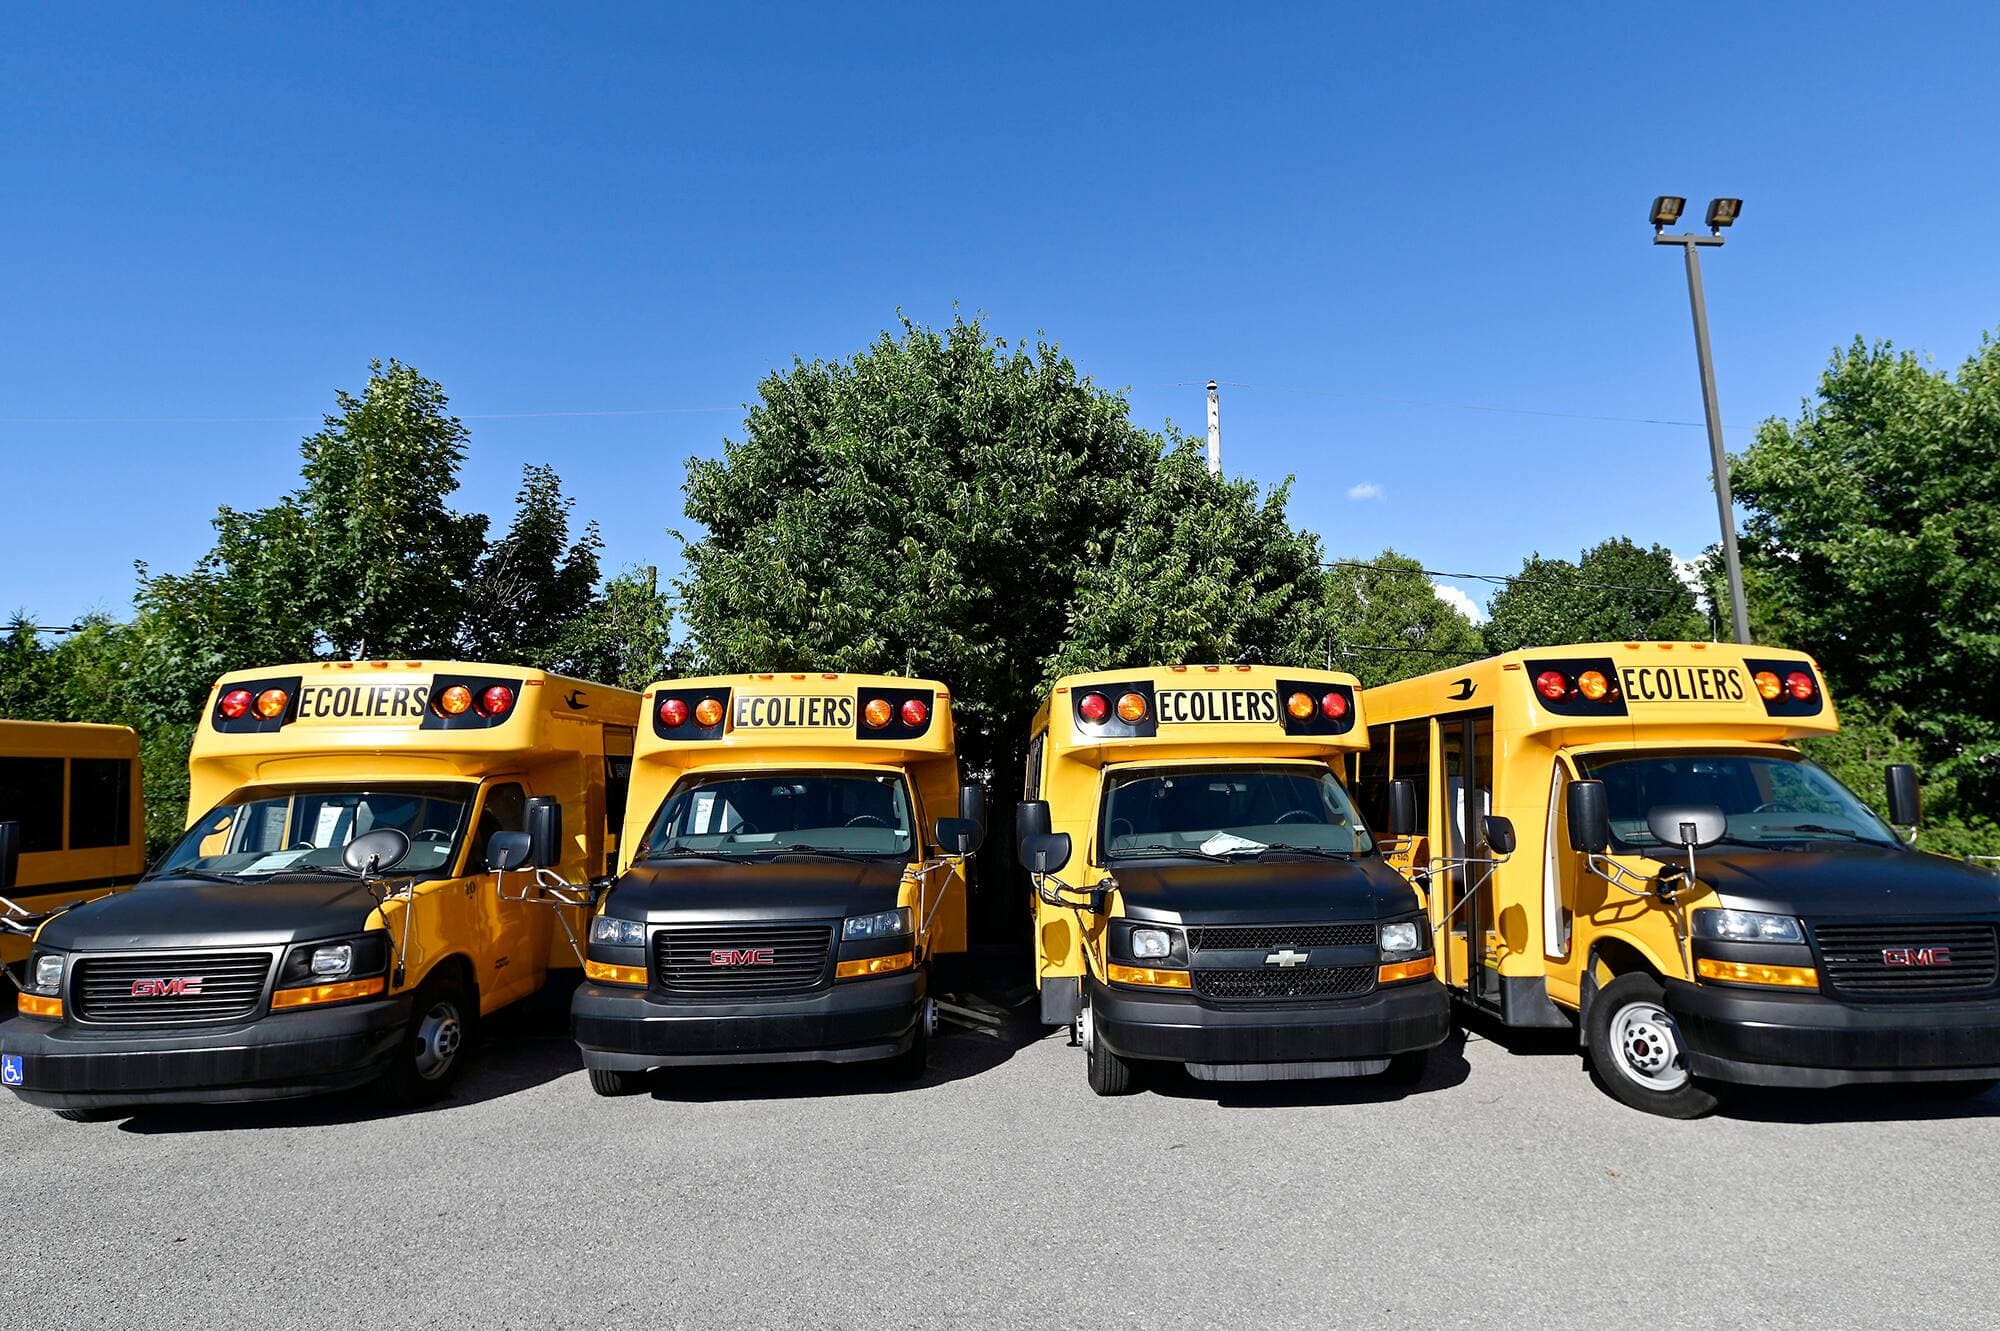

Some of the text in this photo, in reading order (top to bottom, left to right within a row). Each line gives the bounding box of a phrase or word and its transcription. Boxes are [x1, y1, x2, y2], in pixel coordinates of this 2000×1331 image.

[1622, 669, 1743, 700] ECOLIERS
[299, 687, 428, 718] ECOLIERS
[736, 698, 851, 726] ECOLIERS
[1160, 692, 1275, 721] ECOLIERS
[711, 949, 774, 965] GMC
[1882, 947, 1952, 966] GMC
[131, 977, 203, 996] GMC
